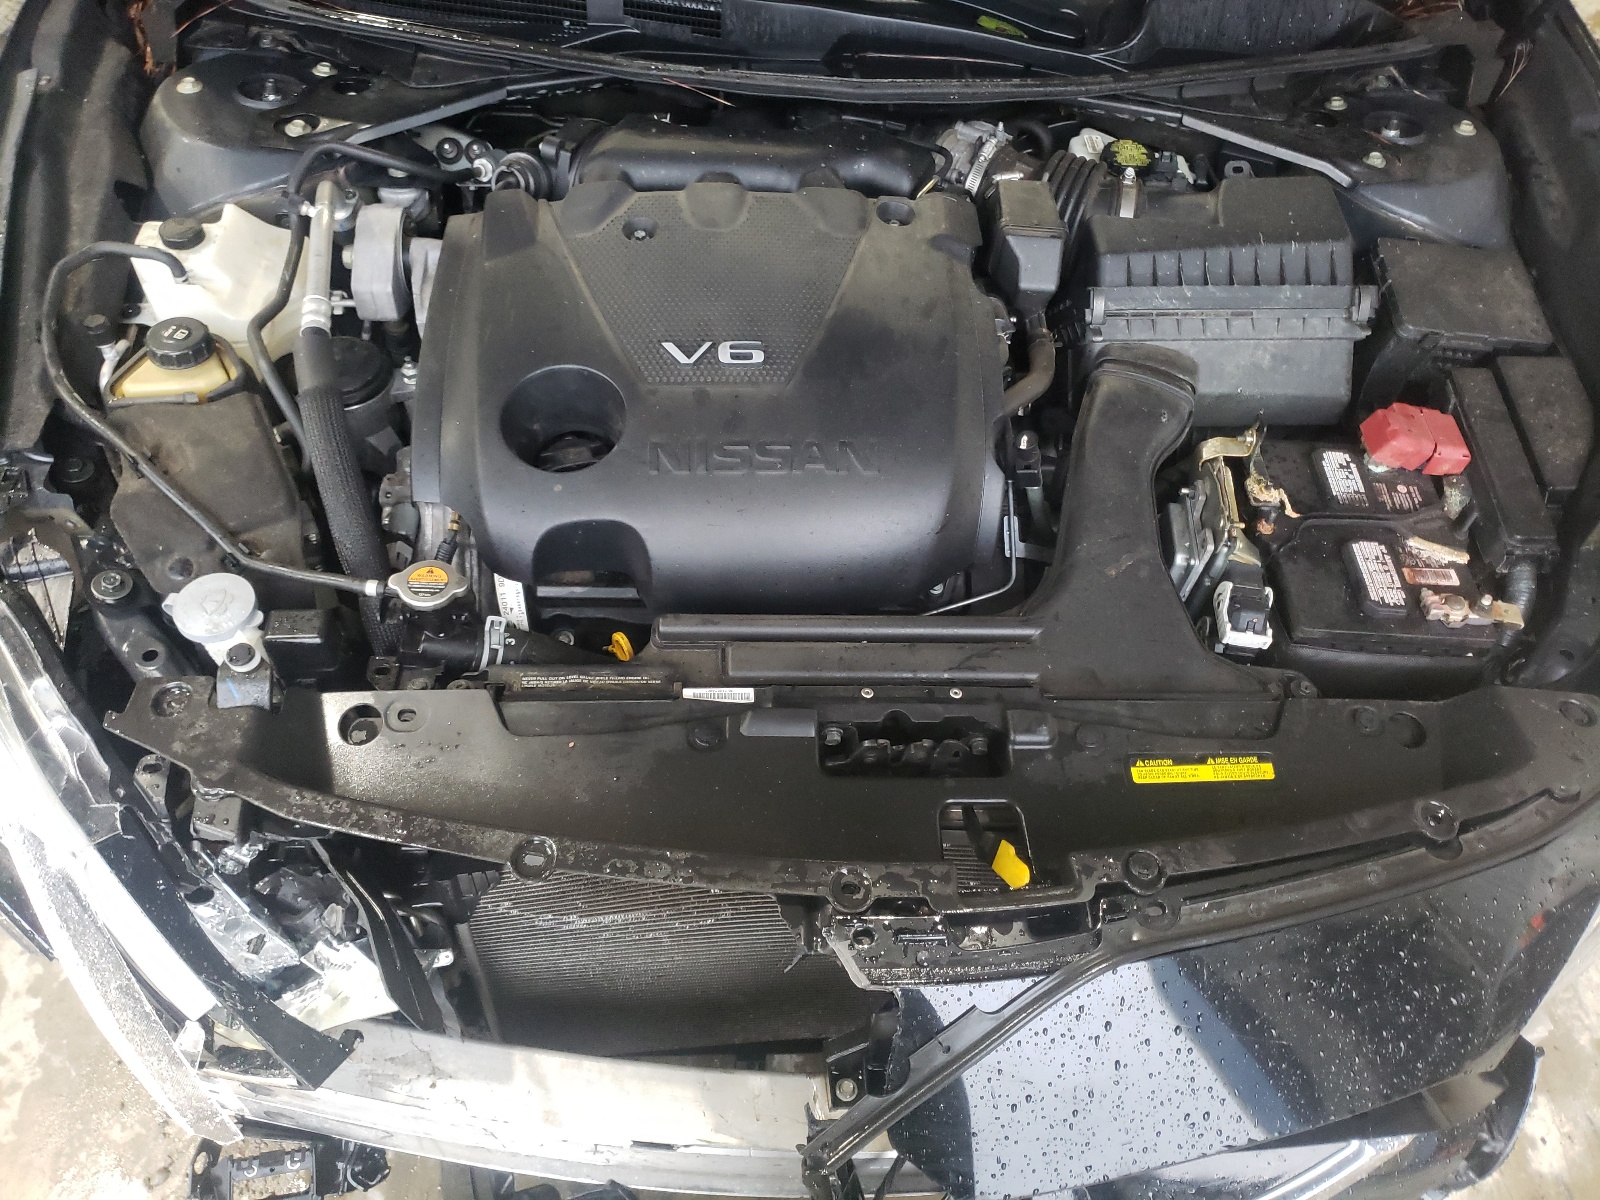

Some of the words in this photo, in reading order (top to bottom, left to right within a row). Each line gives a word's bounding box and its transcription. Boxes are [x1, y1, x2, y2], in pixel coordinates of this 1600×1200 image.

[661, 341, 765, 364] V6
[649, 440, 881, 475] NISSAN
[500, 593, 509, 615] 24011
[505, 638, 516, 646] 3
[1238, 756, 1259, 764] GARDE
